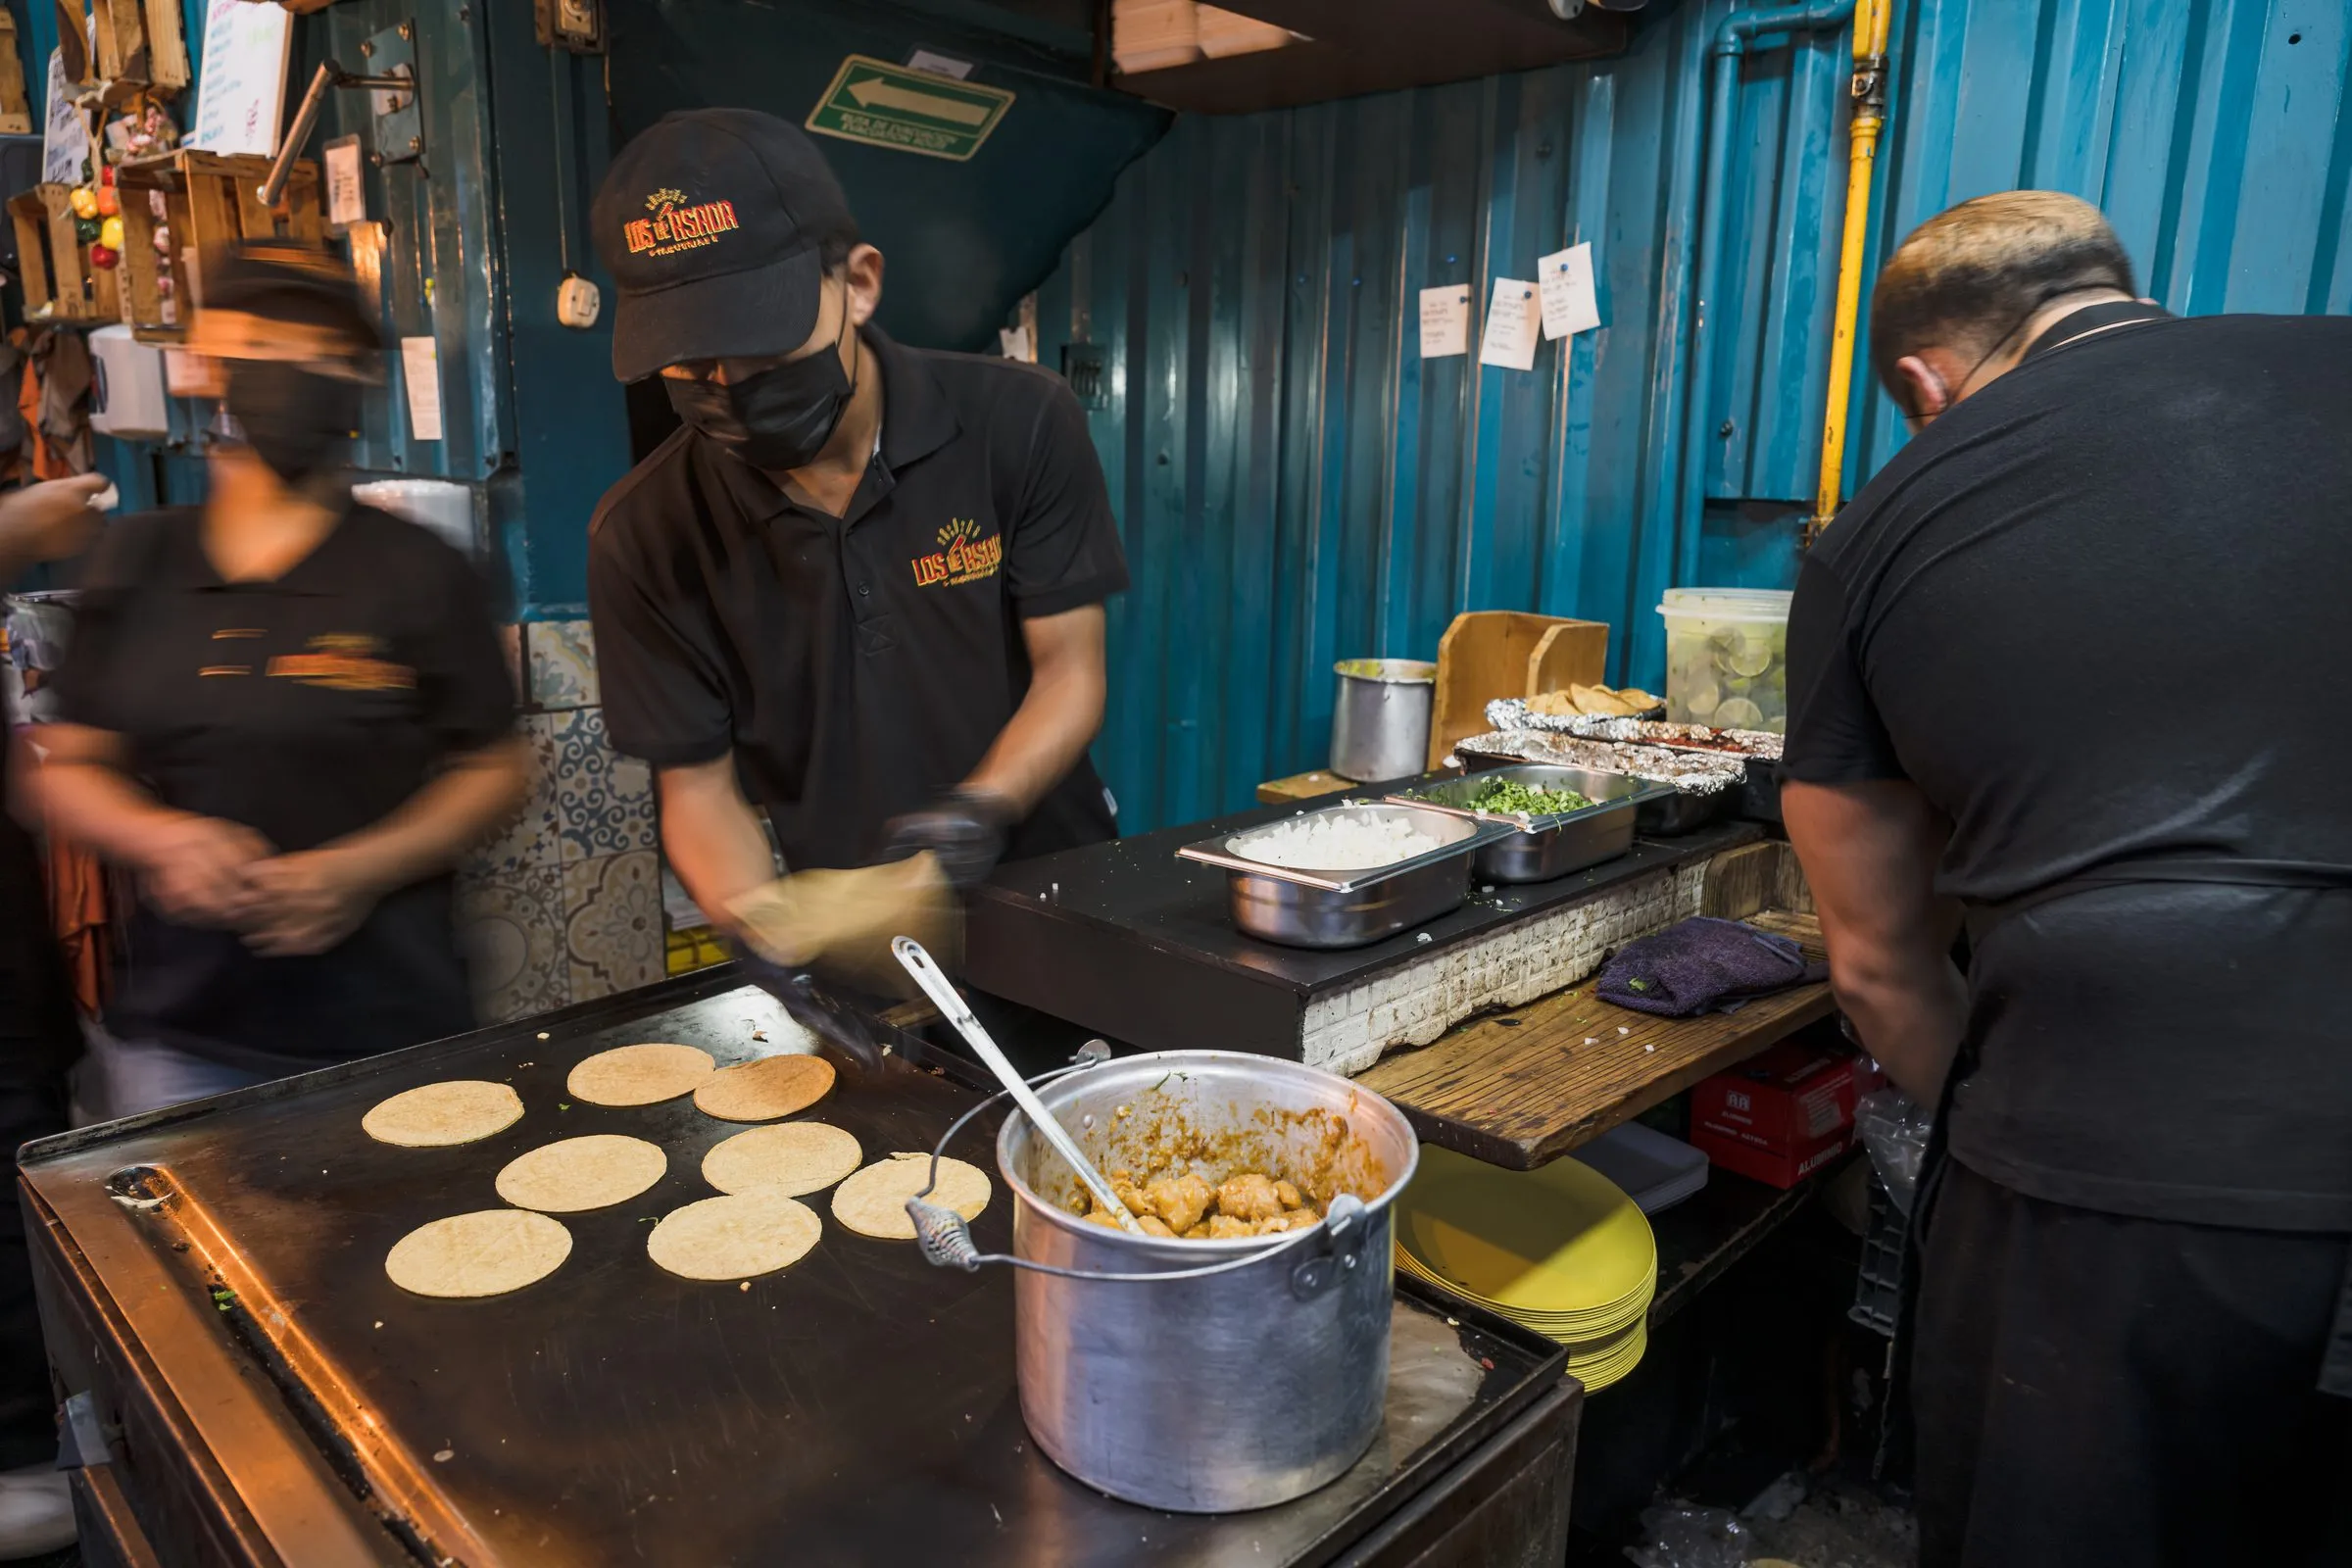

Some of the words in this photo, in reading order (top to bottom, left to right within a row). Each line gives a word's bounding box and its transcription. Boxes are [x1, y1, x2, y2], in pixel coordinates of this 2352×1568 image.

[624, 218, 656, 254] LOS
[668, 199, 739, 242] ASADA
[911, 552, 949, 587] LOS
